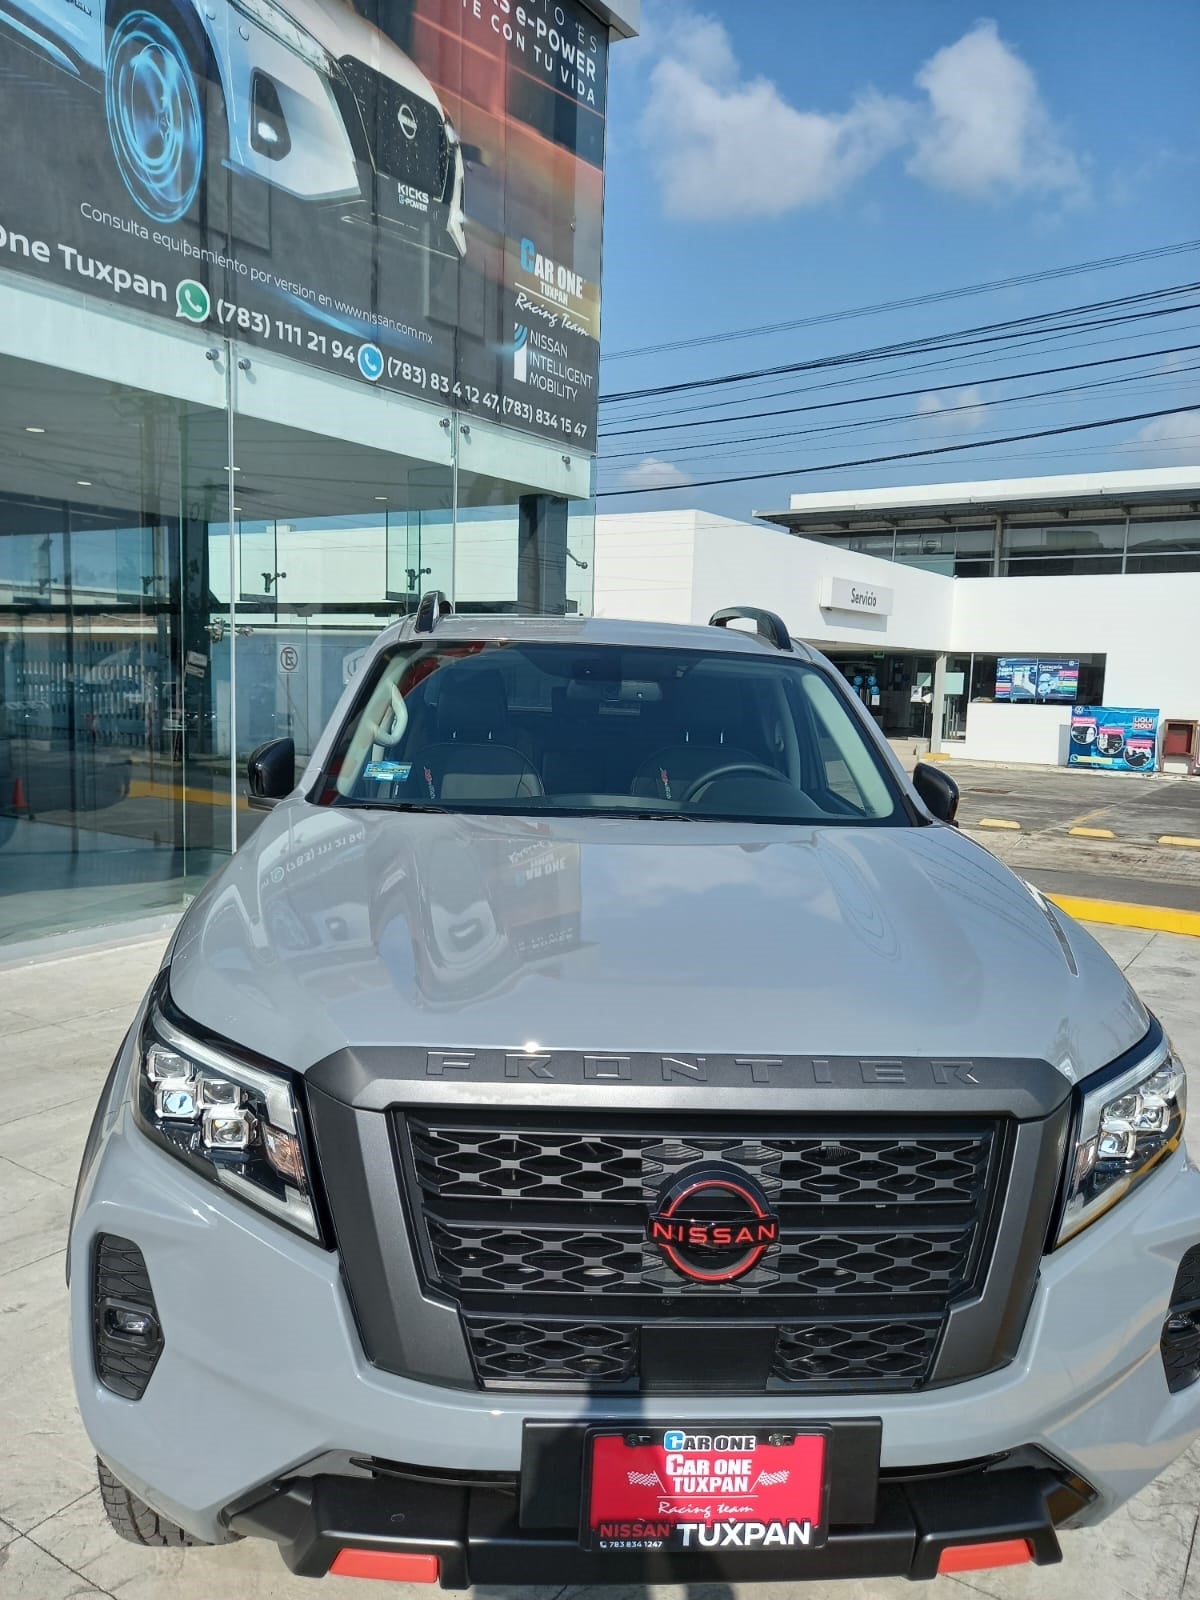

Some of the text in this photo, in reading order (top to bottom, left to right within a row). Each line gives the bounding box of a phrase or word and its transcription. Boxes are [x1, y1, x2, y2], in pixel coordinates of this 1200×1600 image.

[491, 14, 525, 52] CON
[533, 45, 553, 71] TU
[561, 65, 596, 105] VIDA
[397, 182, 429, 204] KICKS
[57, 243, 168, 302] Tuxpan
[80, 202, 149, 240] Consulta
[152, 232, 248, 275] equipamiento
[250, 266, 272, 284] por
[318, 291, 333, 308] en
[334, 299, 433, 345] www.nissan.com.mx
[521, 237, 584, 300] CAR ONE
[539, 281, 569, 307] TUXPAN
[514, 291, 590, 336] Racing Team
[216, 299, 356, 365] (783) 111 21 94
[530, 329, 568, 359] NISSAN
[529, 351, 593, 389] INTELLIGENT
[387, 356, 427, 389] (783)
[465, 385, 480, 404] 12
[502, 395, 533, 423] (783)
[535, 408, 558, 429] 834
[560, 417, 572, 433] 15
[574, 422, 588, 438] 47
[529, 371, 578, 402] MOBILITY
[850, 587, 877, 607] Servicio
[426, 1050, 980, 1085] FRONTIER
[652, 1221, 776, 1245] NISSAN
[664, 1430, 756, 1452] CAR ONE
[665, 1453, 753, 1476] CAR ONE
[672, 1476, 749, 1494] TUXPAN
[658, 1501, 755, 1519] Racing team
[600, 1522, 811, 1547] NISSAN TUXPAN
[608, 1540, 663, 1549] 783 834 1247
